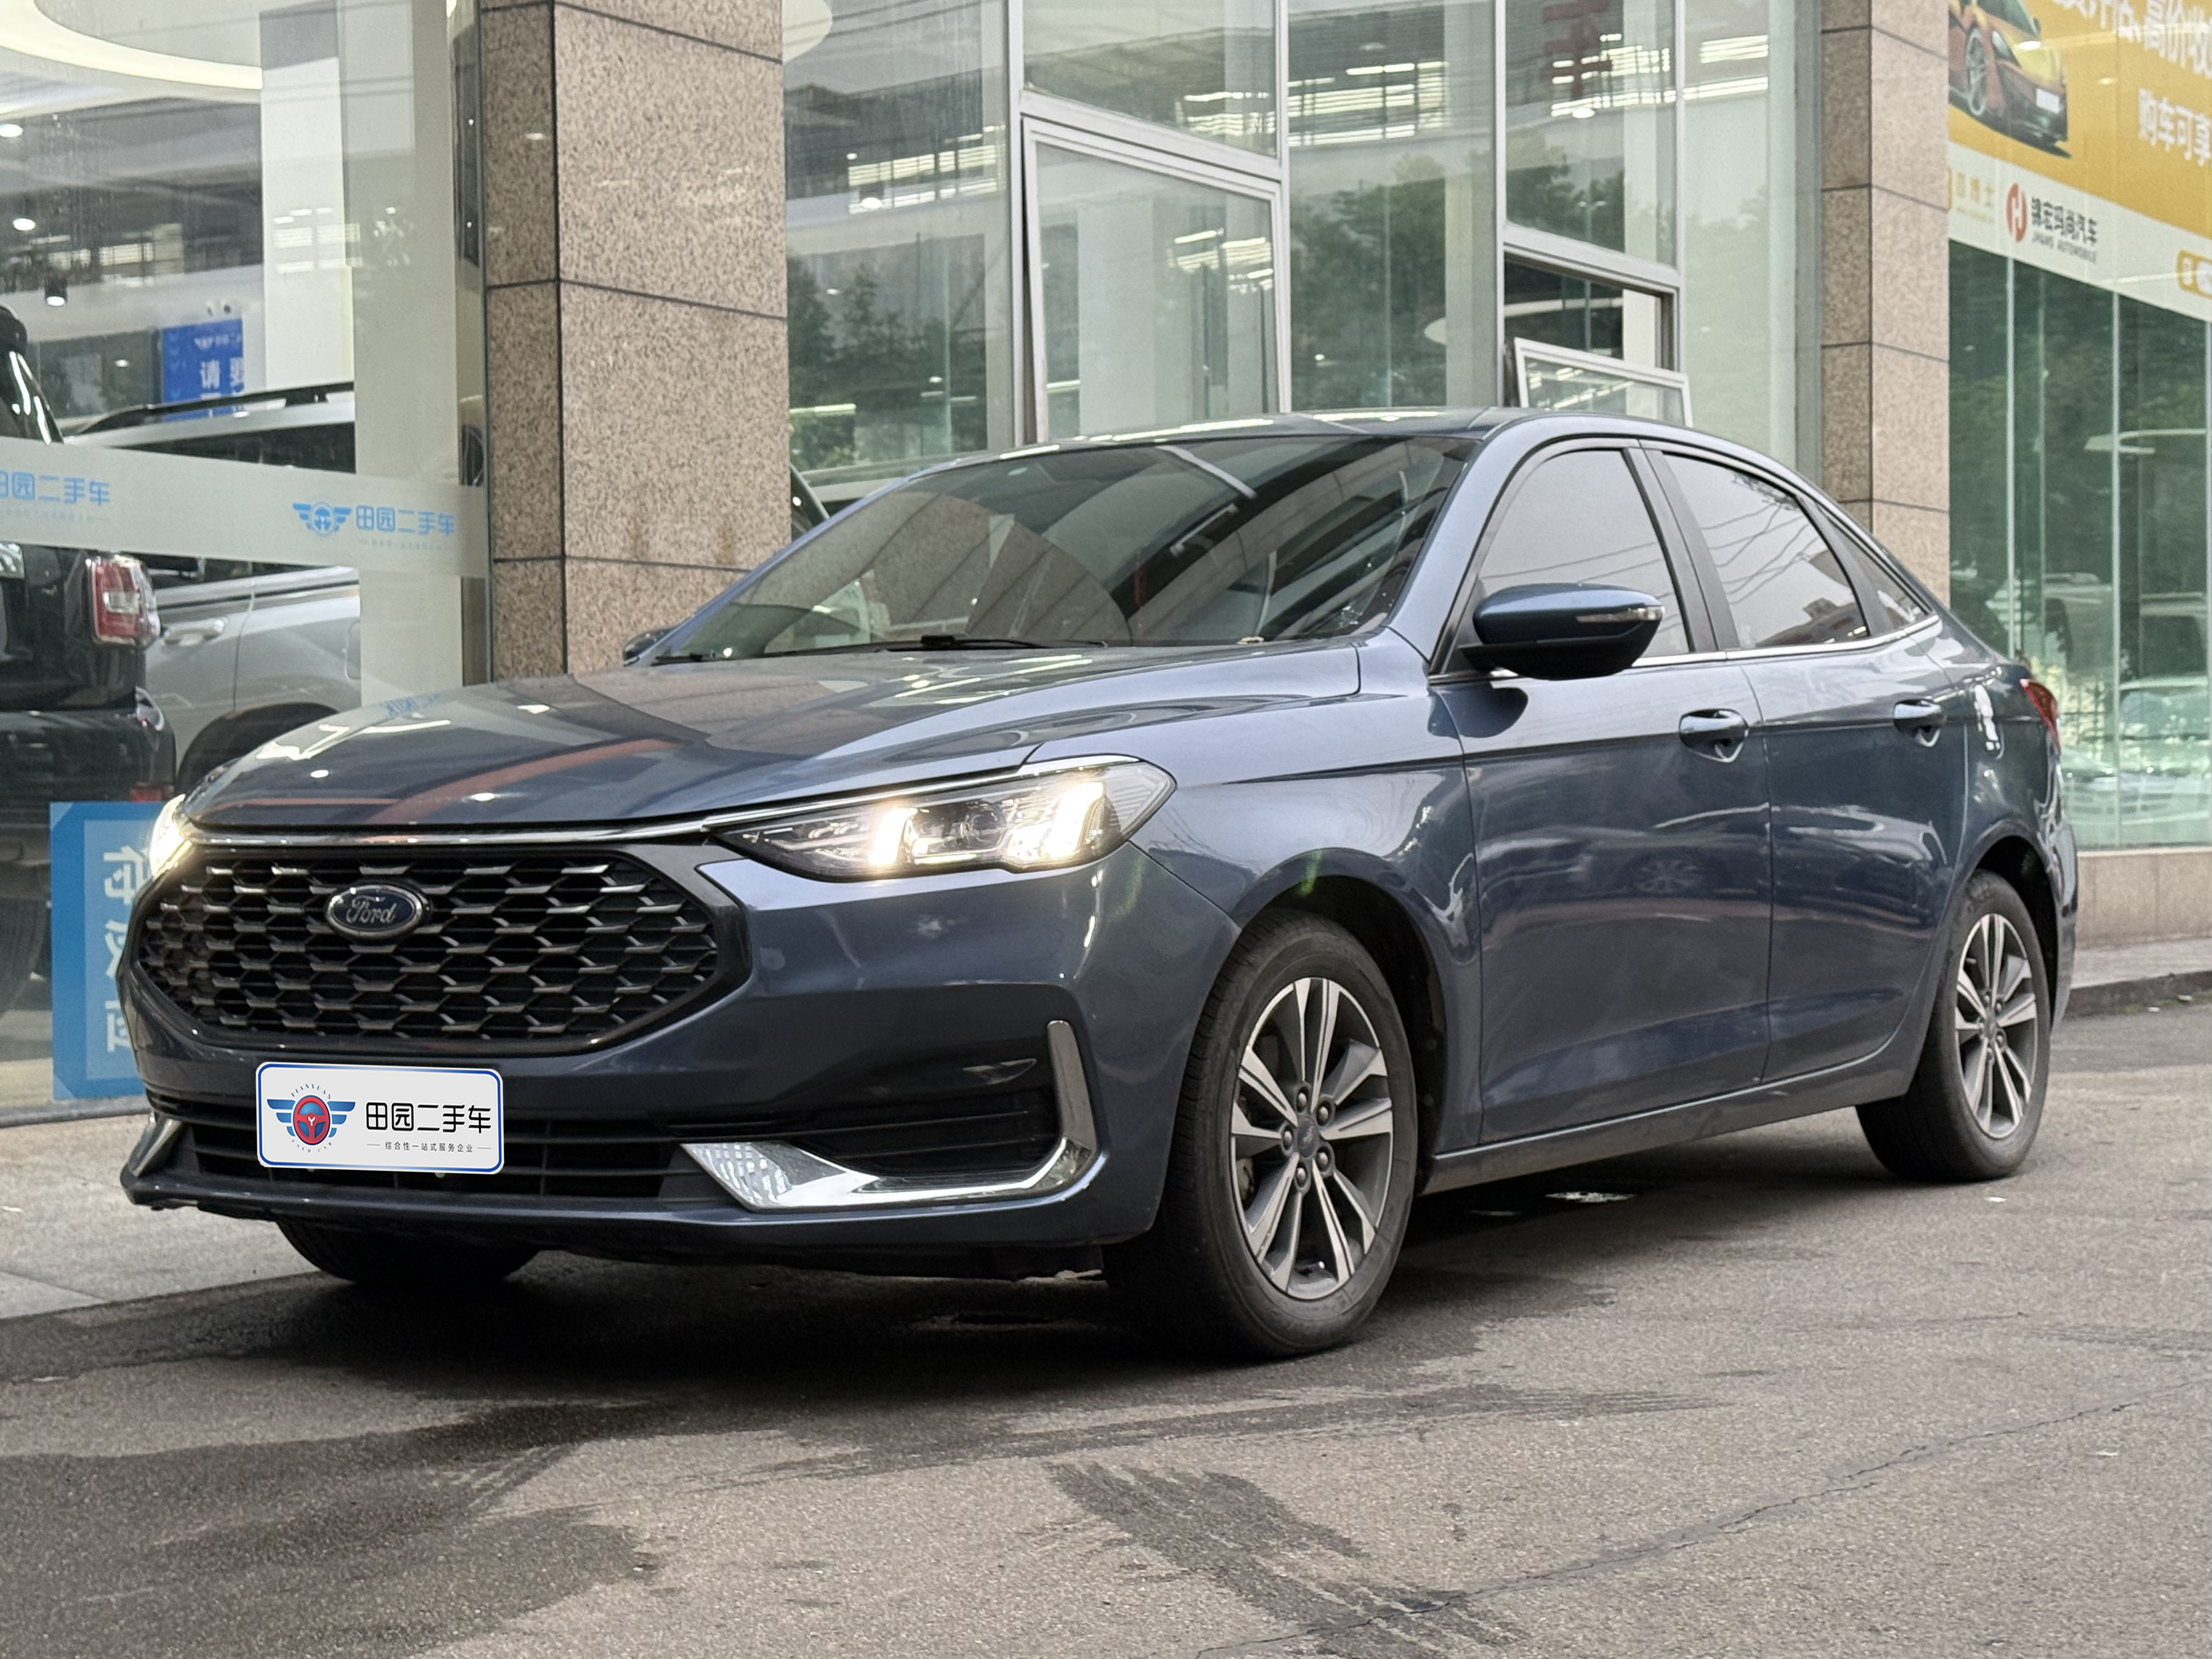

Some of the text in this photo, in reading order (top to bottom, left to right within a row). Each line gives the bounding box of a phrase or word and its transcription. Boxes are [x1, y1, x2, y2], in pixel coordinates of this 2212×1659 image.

[356, 505, 456, 537] 田园二手车
[346, 895, 398, 924] Ford
